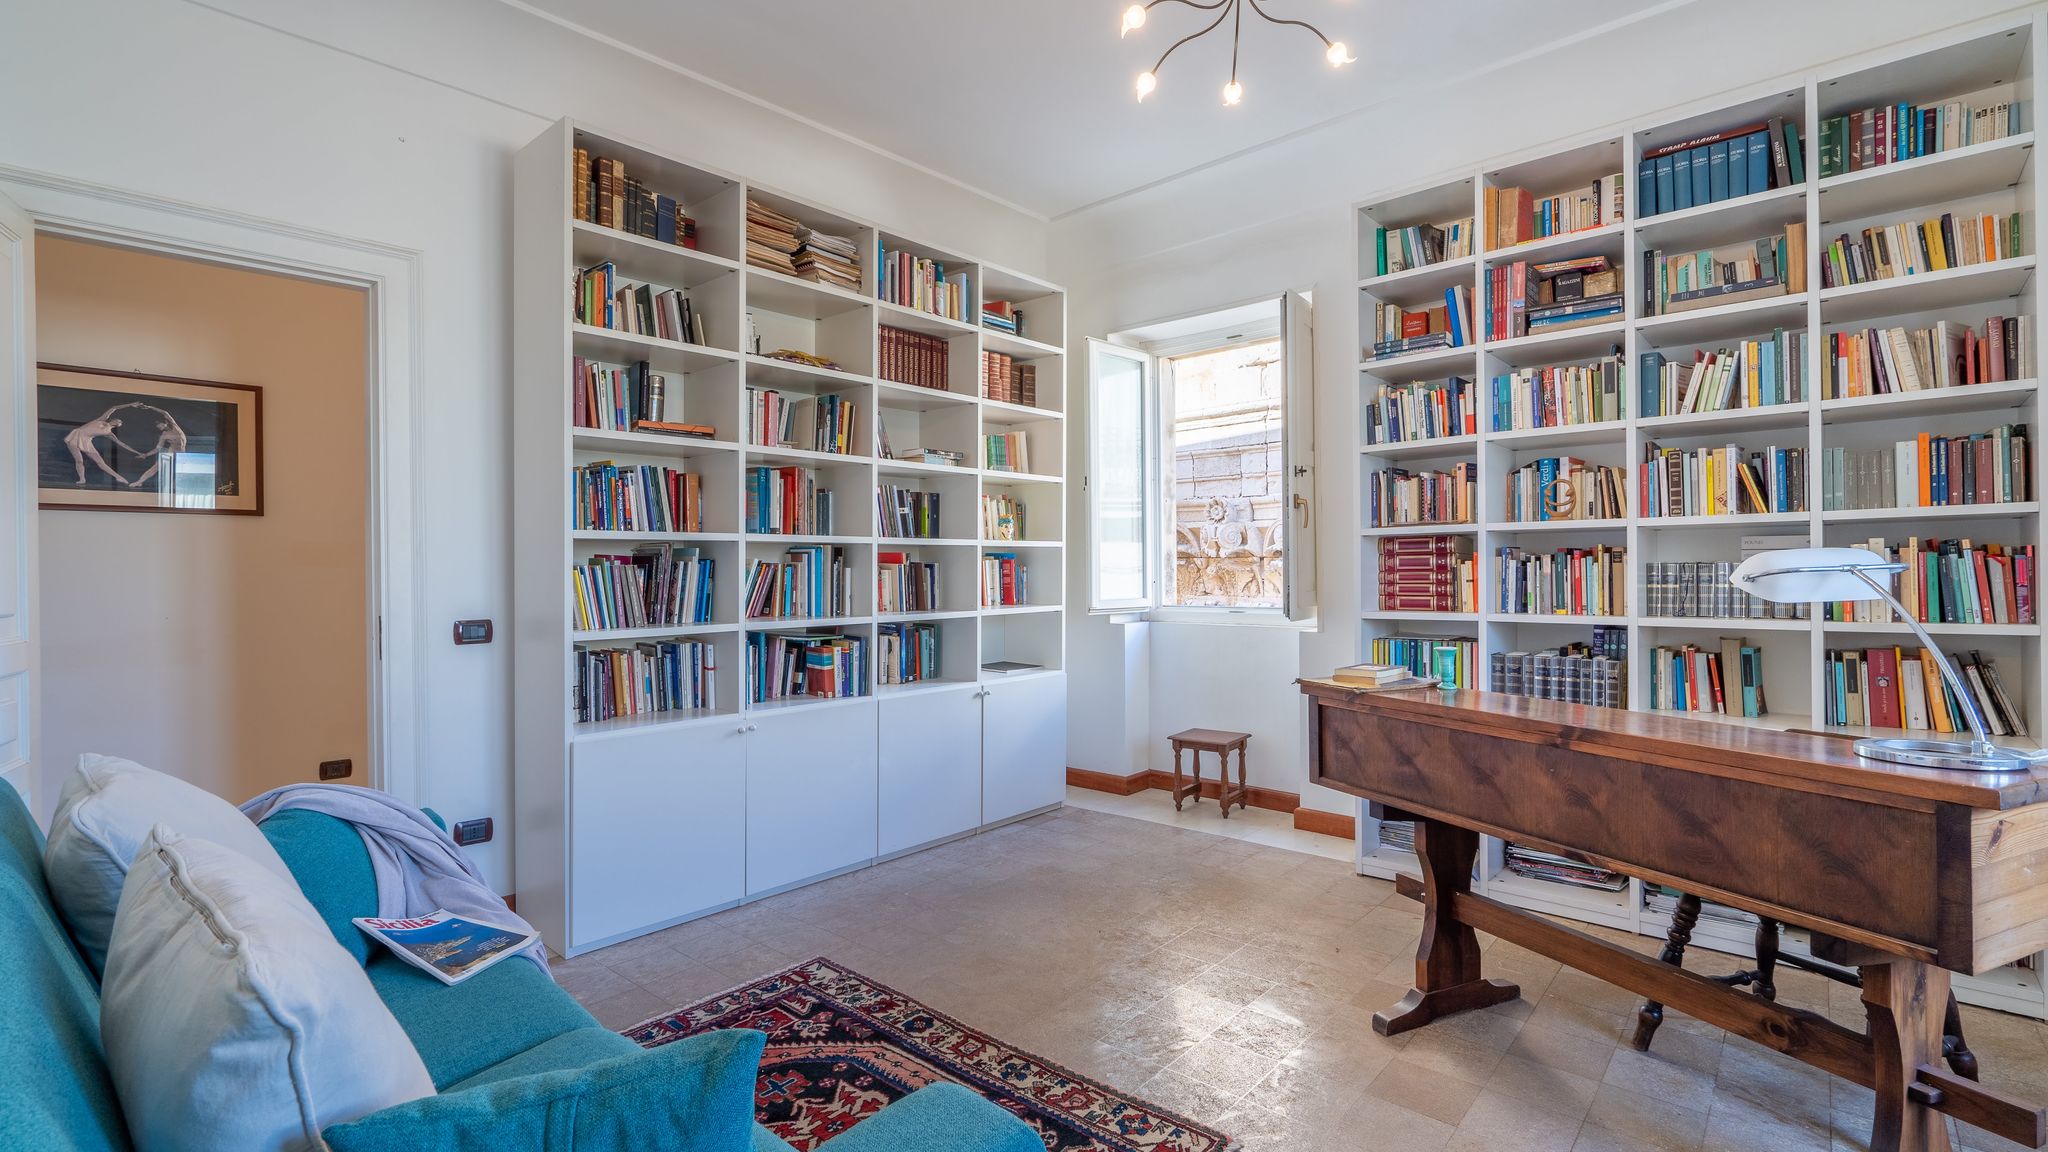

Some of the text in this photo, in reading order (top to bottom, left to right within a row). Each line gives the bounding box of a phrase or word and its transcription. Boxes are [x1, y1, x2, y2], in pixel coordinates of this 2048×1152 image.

[1658, 133, 1721, 153] STAMP ALBUM
[1541, 465, 1549, 487] Verdi
[364, 918, 440, 930] Sicilia
